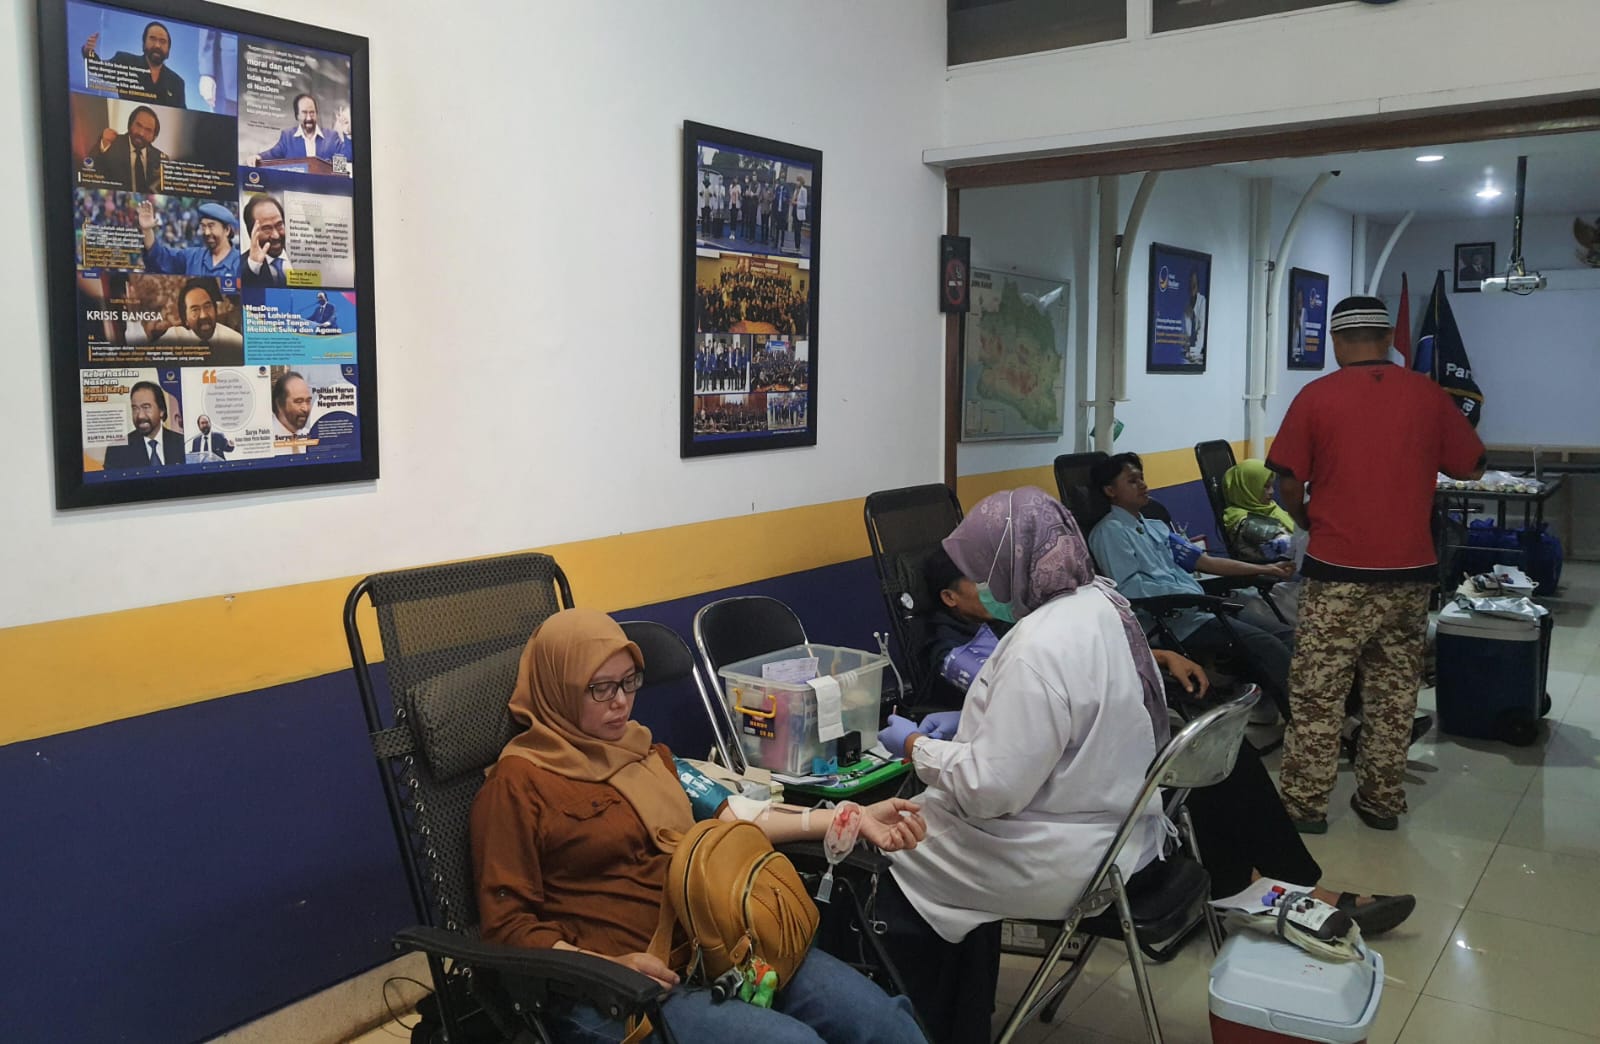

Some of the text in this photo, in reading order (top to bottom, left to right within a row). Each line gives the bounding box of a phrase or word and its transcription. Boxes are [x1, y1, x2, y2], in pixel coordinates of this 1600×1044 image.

[269, 61, 282, 70] dan
[86, 310, 163, 321] KRISIS BANGSA
[83, 369, 139, 378] Keberhasilan
